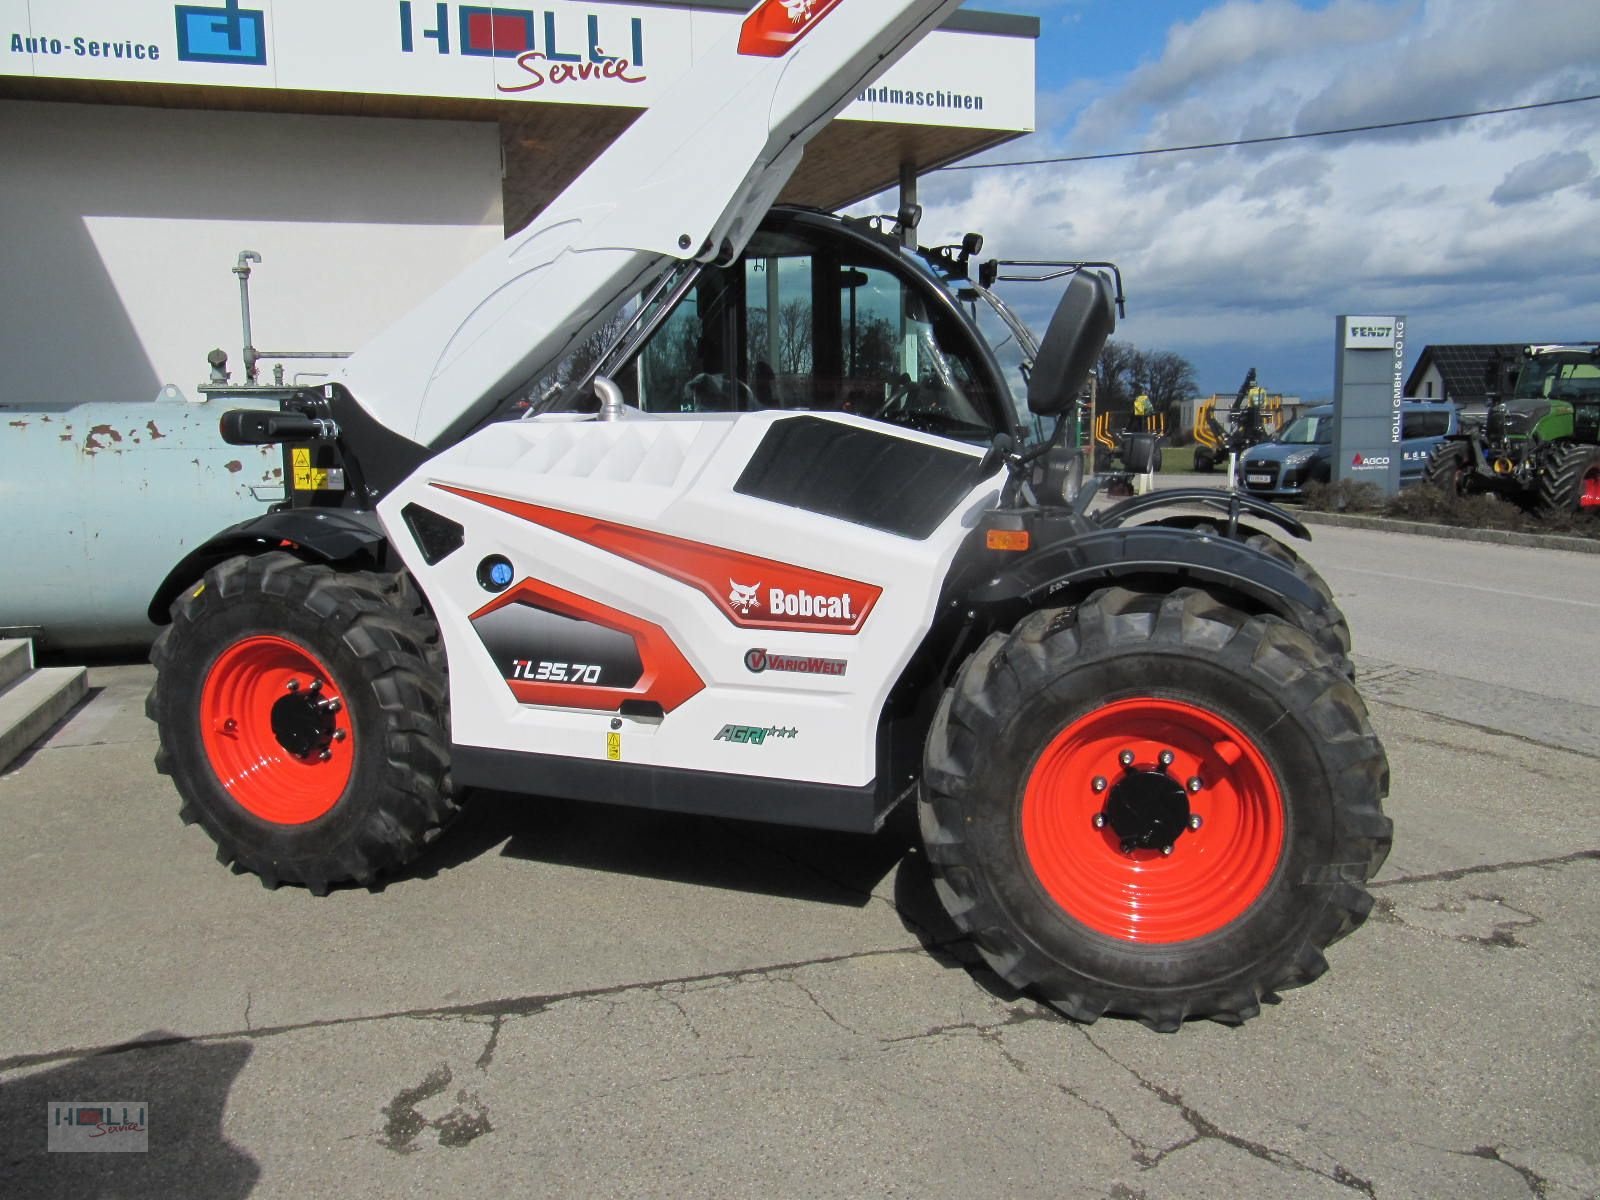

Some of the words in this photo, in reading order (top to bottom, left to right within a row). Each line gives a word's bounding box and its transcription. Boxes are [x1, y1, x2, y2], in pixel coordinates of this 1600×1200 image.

[11, 33, 160, 60] Auto-Service
[400, 1, 643, 66] HOLLI
[497, 52, 647, 92] Service
[1351, 327, 1392, 337] FENDT
[1396, 321, 1404, 338] KG
[1395, 341, 1404, 358] CO
[1394, 361, 1402, 369] &
[1393, 372, 1402, 408] GMBH
[1392, 410, 1400, 443] HOLLI
[1362, 457, 1390, 465] AGCO
[769, 588, 851, 619] Bobcat
[512, 659, 602, 684] TL35.70
